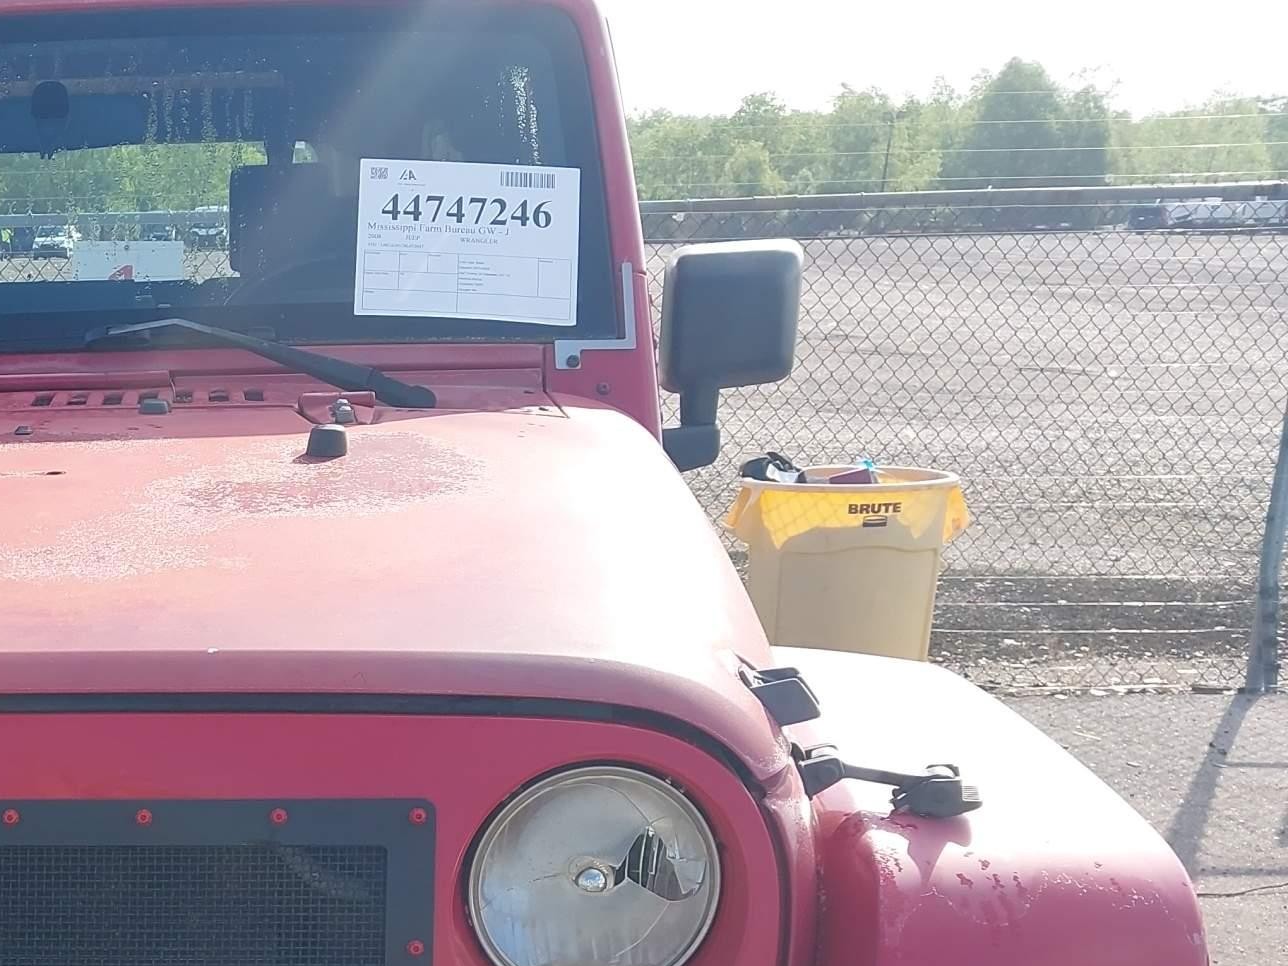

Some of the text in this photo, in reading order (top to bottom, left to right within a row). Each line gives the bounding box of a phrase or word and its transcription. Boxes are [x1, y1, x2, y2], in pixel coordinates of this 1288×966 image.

[381, 193, 553, 229] 44747246
[367, 222, 417, 233] Mississippi
[419, 223, 443, 232] Farm
[444, 225, 476, 234] Bureau
[478, 226, 496, 235] GW
[847, 502, 902, 515] BRUTE
